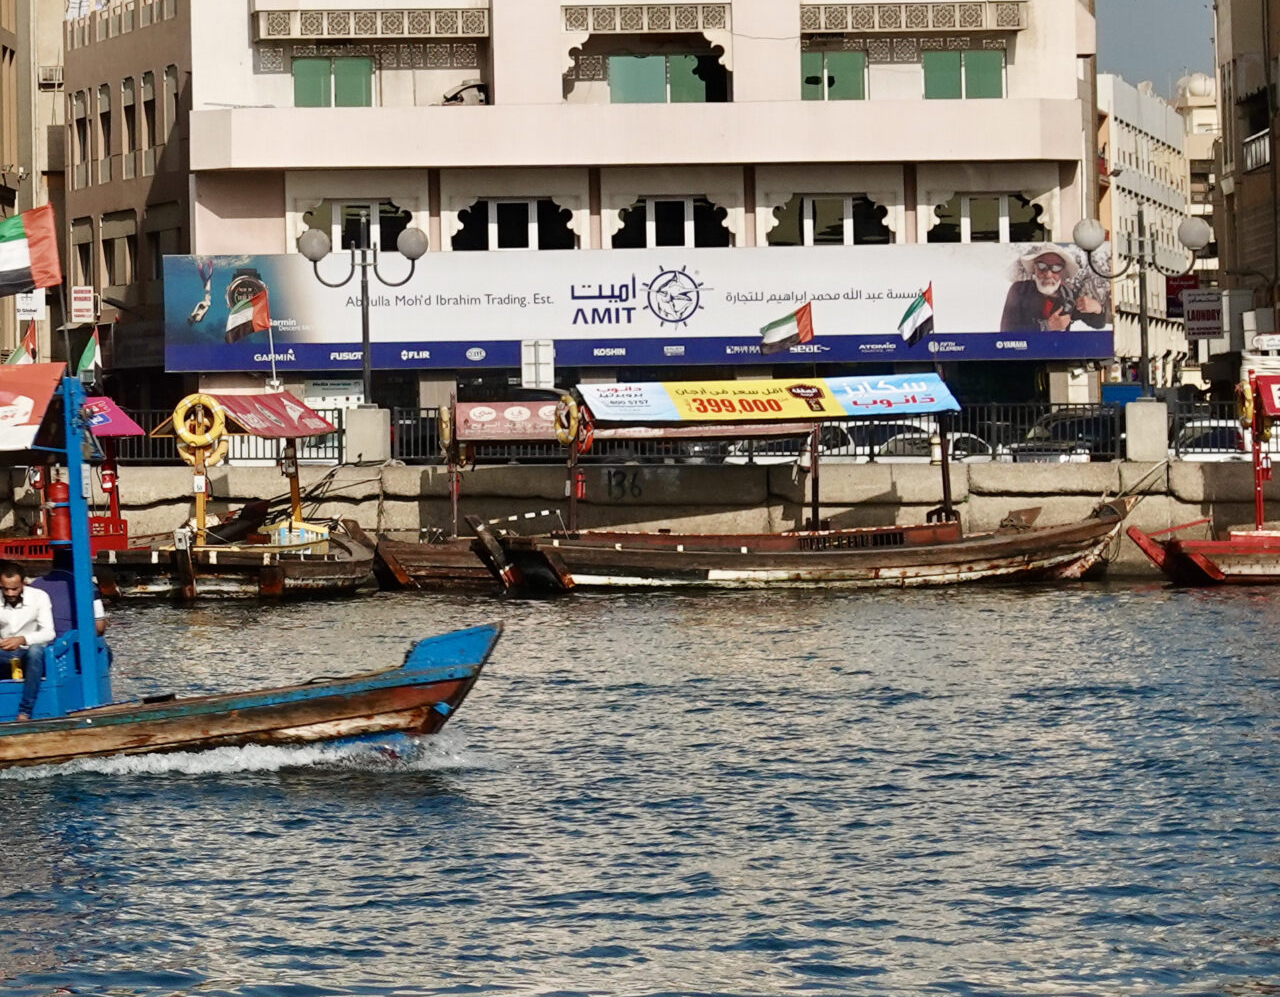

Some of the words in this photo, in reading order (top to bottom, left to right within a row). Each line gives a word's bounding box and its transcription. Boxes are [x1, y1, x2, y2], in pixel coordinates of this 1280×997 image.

[346, 294, 390, 307] Abulla
[395, 295, 432, 307] Moh'd
[436, 295, 481, 306] Ibrahim
[484, 294, 530, 308] Trading.
[534, 293, 554, 305] Est.
[725, 290, 764, 304] للتجارة
[811, 293, 841, 302] محمد
[843, 290, 862, 301] الله
[865, 291, 884, 303] عبد
[887, 289, 924, 301] ؤسسة
[573, 307, 636, 324] AMIT
[1187, 309, 1221, 321] LAUNDRY
[254, 353, 295, 361] GARMIN
[409, 351, 430, 359] FLIR
[593, 348, 626, 356] KOSHIN
[692, 397, 783, 414] 399,000
[608, 470, 642, 499] 136
